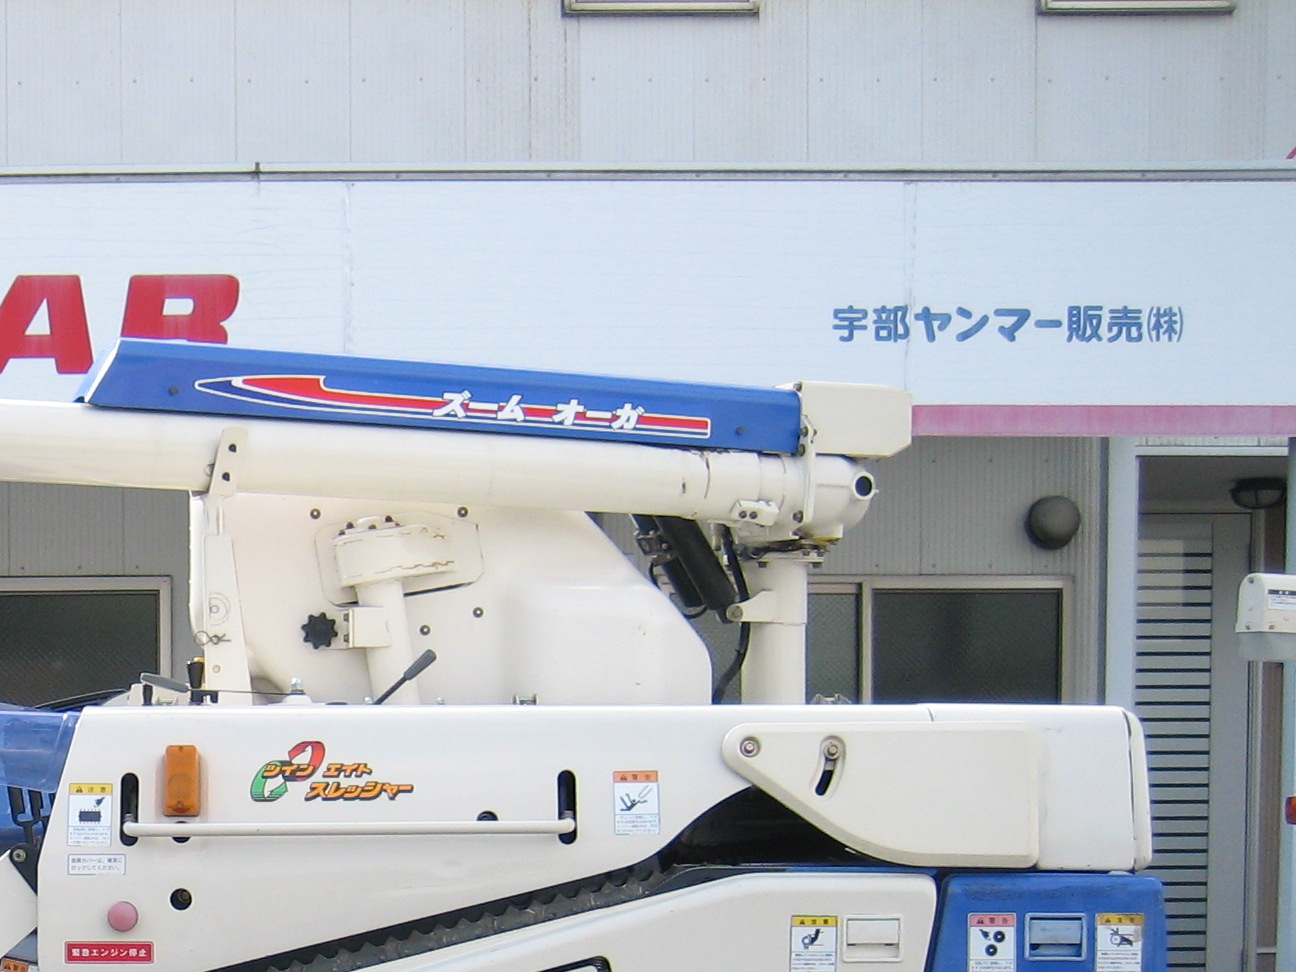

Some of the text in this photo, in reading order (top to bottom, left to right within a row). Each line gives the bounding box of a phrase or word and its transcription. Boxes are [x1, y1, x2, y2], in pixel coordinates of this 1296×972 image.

[432, 390, 646, 431] ズーム オーガ
[262, 763, 373, 778] ツイン エイト
[304, 781, 414, 802] スレッシャー
